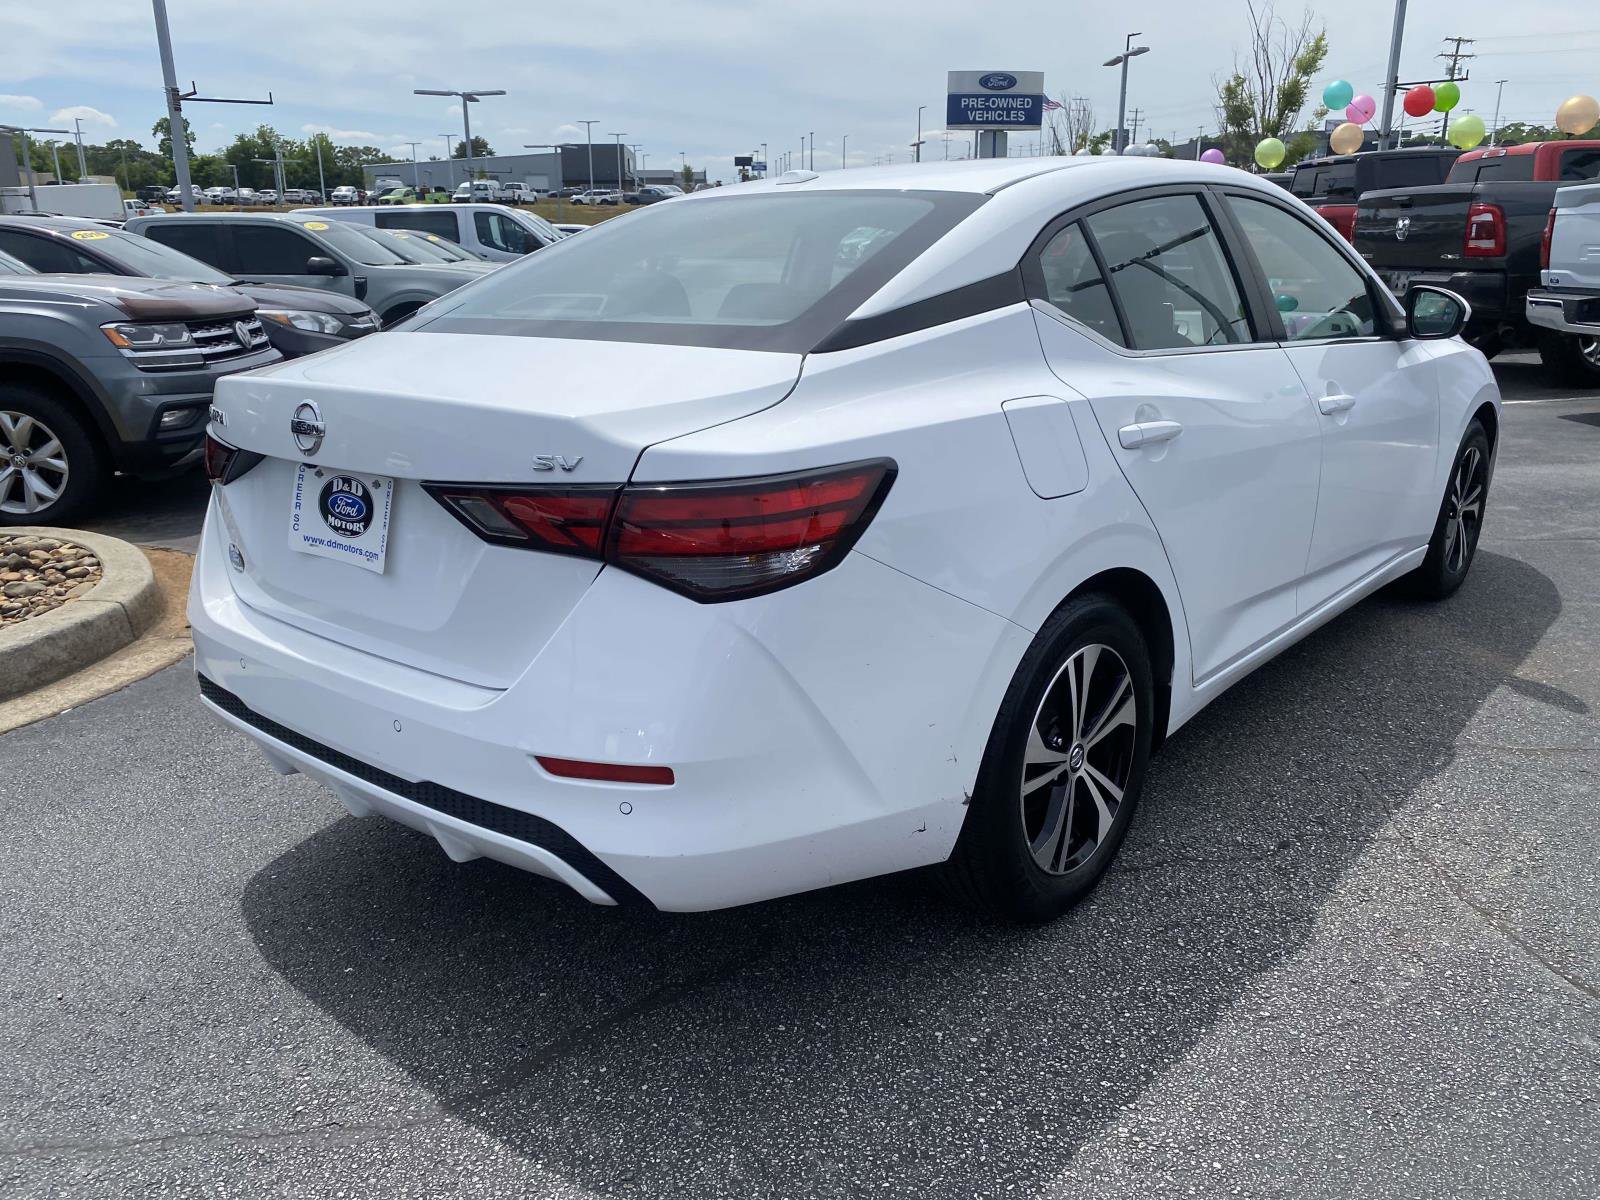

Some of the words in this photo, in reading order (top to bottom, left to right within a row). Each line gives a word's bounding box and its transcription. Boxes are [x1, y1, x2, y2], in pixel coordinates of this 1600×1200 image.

[987, 76, 1009, 87] Ford
[961, 97, 1033, 109] PRE-OWNED
[967, 110, 1025, 121] VEHICLES
[532, 454, 584, 472] SV
[295, 464, 306, 511] GREER
[332, 478, 363, 497] D&D
[334, 496, 360, 517] Ford
[292, 513, 300, 532] SC
[327, 514, 365, 533] MOTORS
[303, 534, 379, 561] www.ddmotors.com
